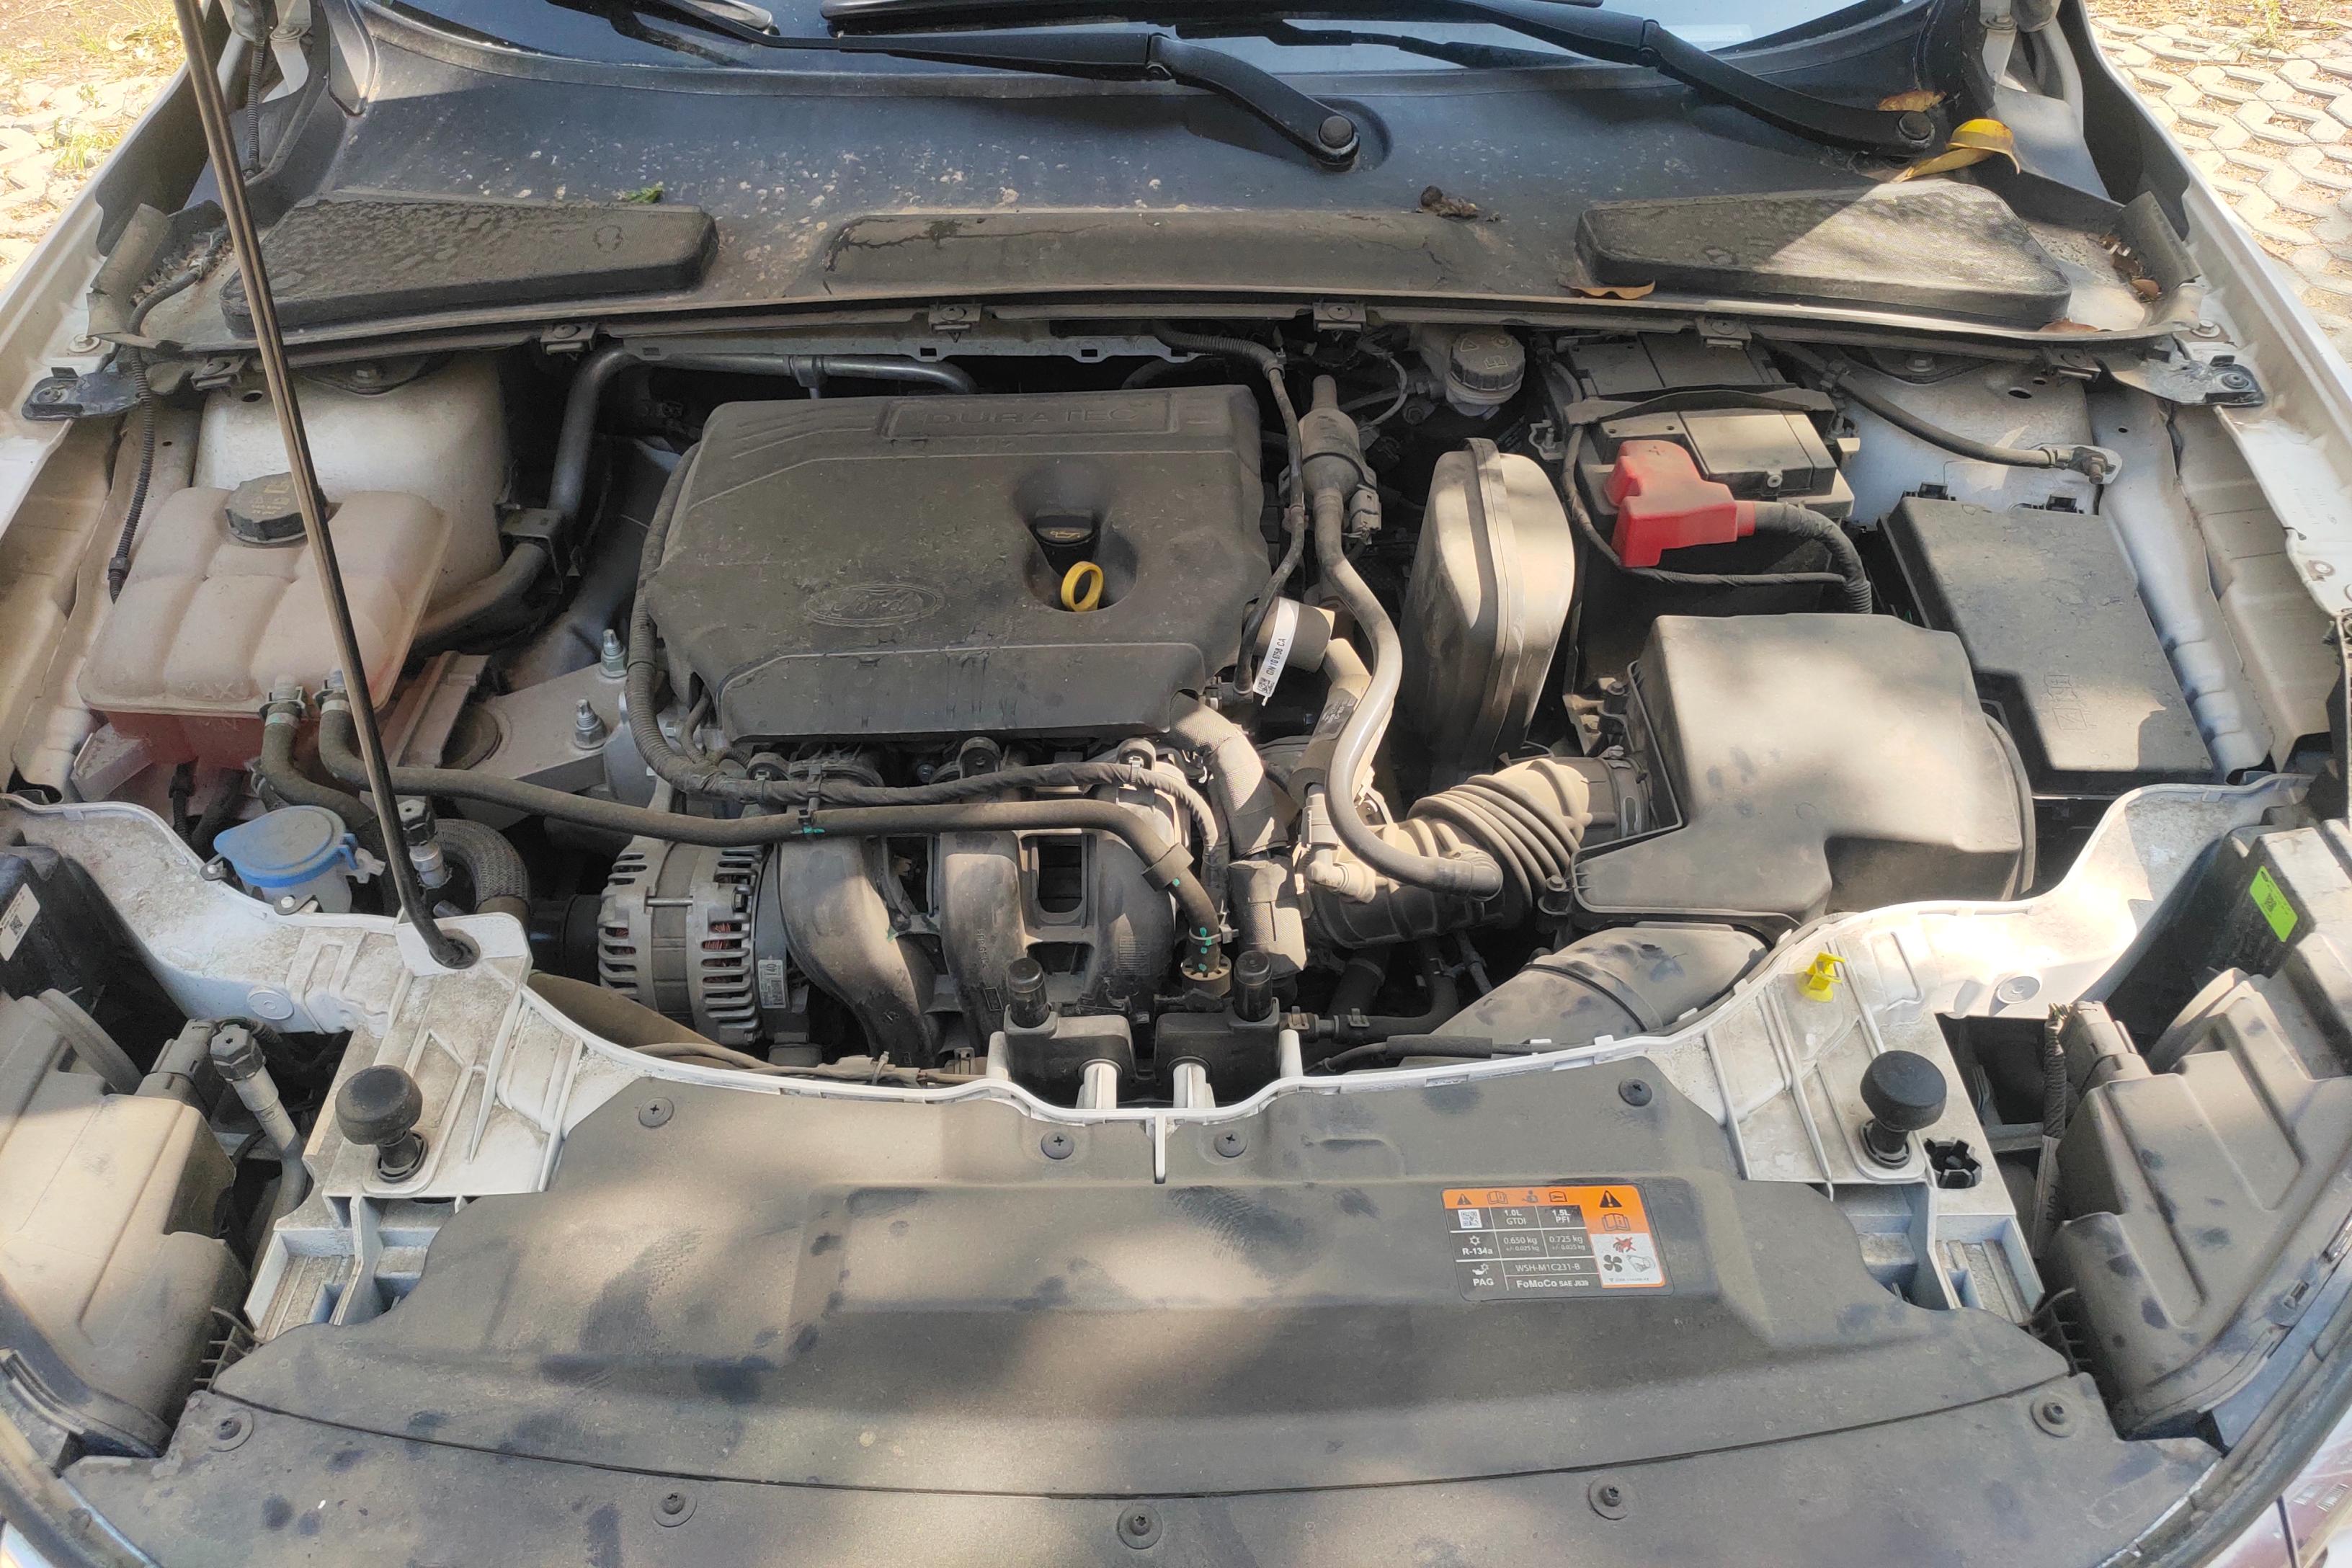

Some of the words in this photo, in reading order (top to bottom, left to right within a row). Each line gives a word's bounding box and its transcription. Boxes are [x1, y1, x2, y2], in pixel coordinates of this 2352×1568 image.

[1276, 638, 1286, 647] CA
[1526, 1237, 1538, 1245] kg
[1572, 1235, 1583, 1244] kg
[1515, 1263, 1580, 1272] WSH-M1C231-B
[1516, 1280, 1558, 1288] FoMoCo
